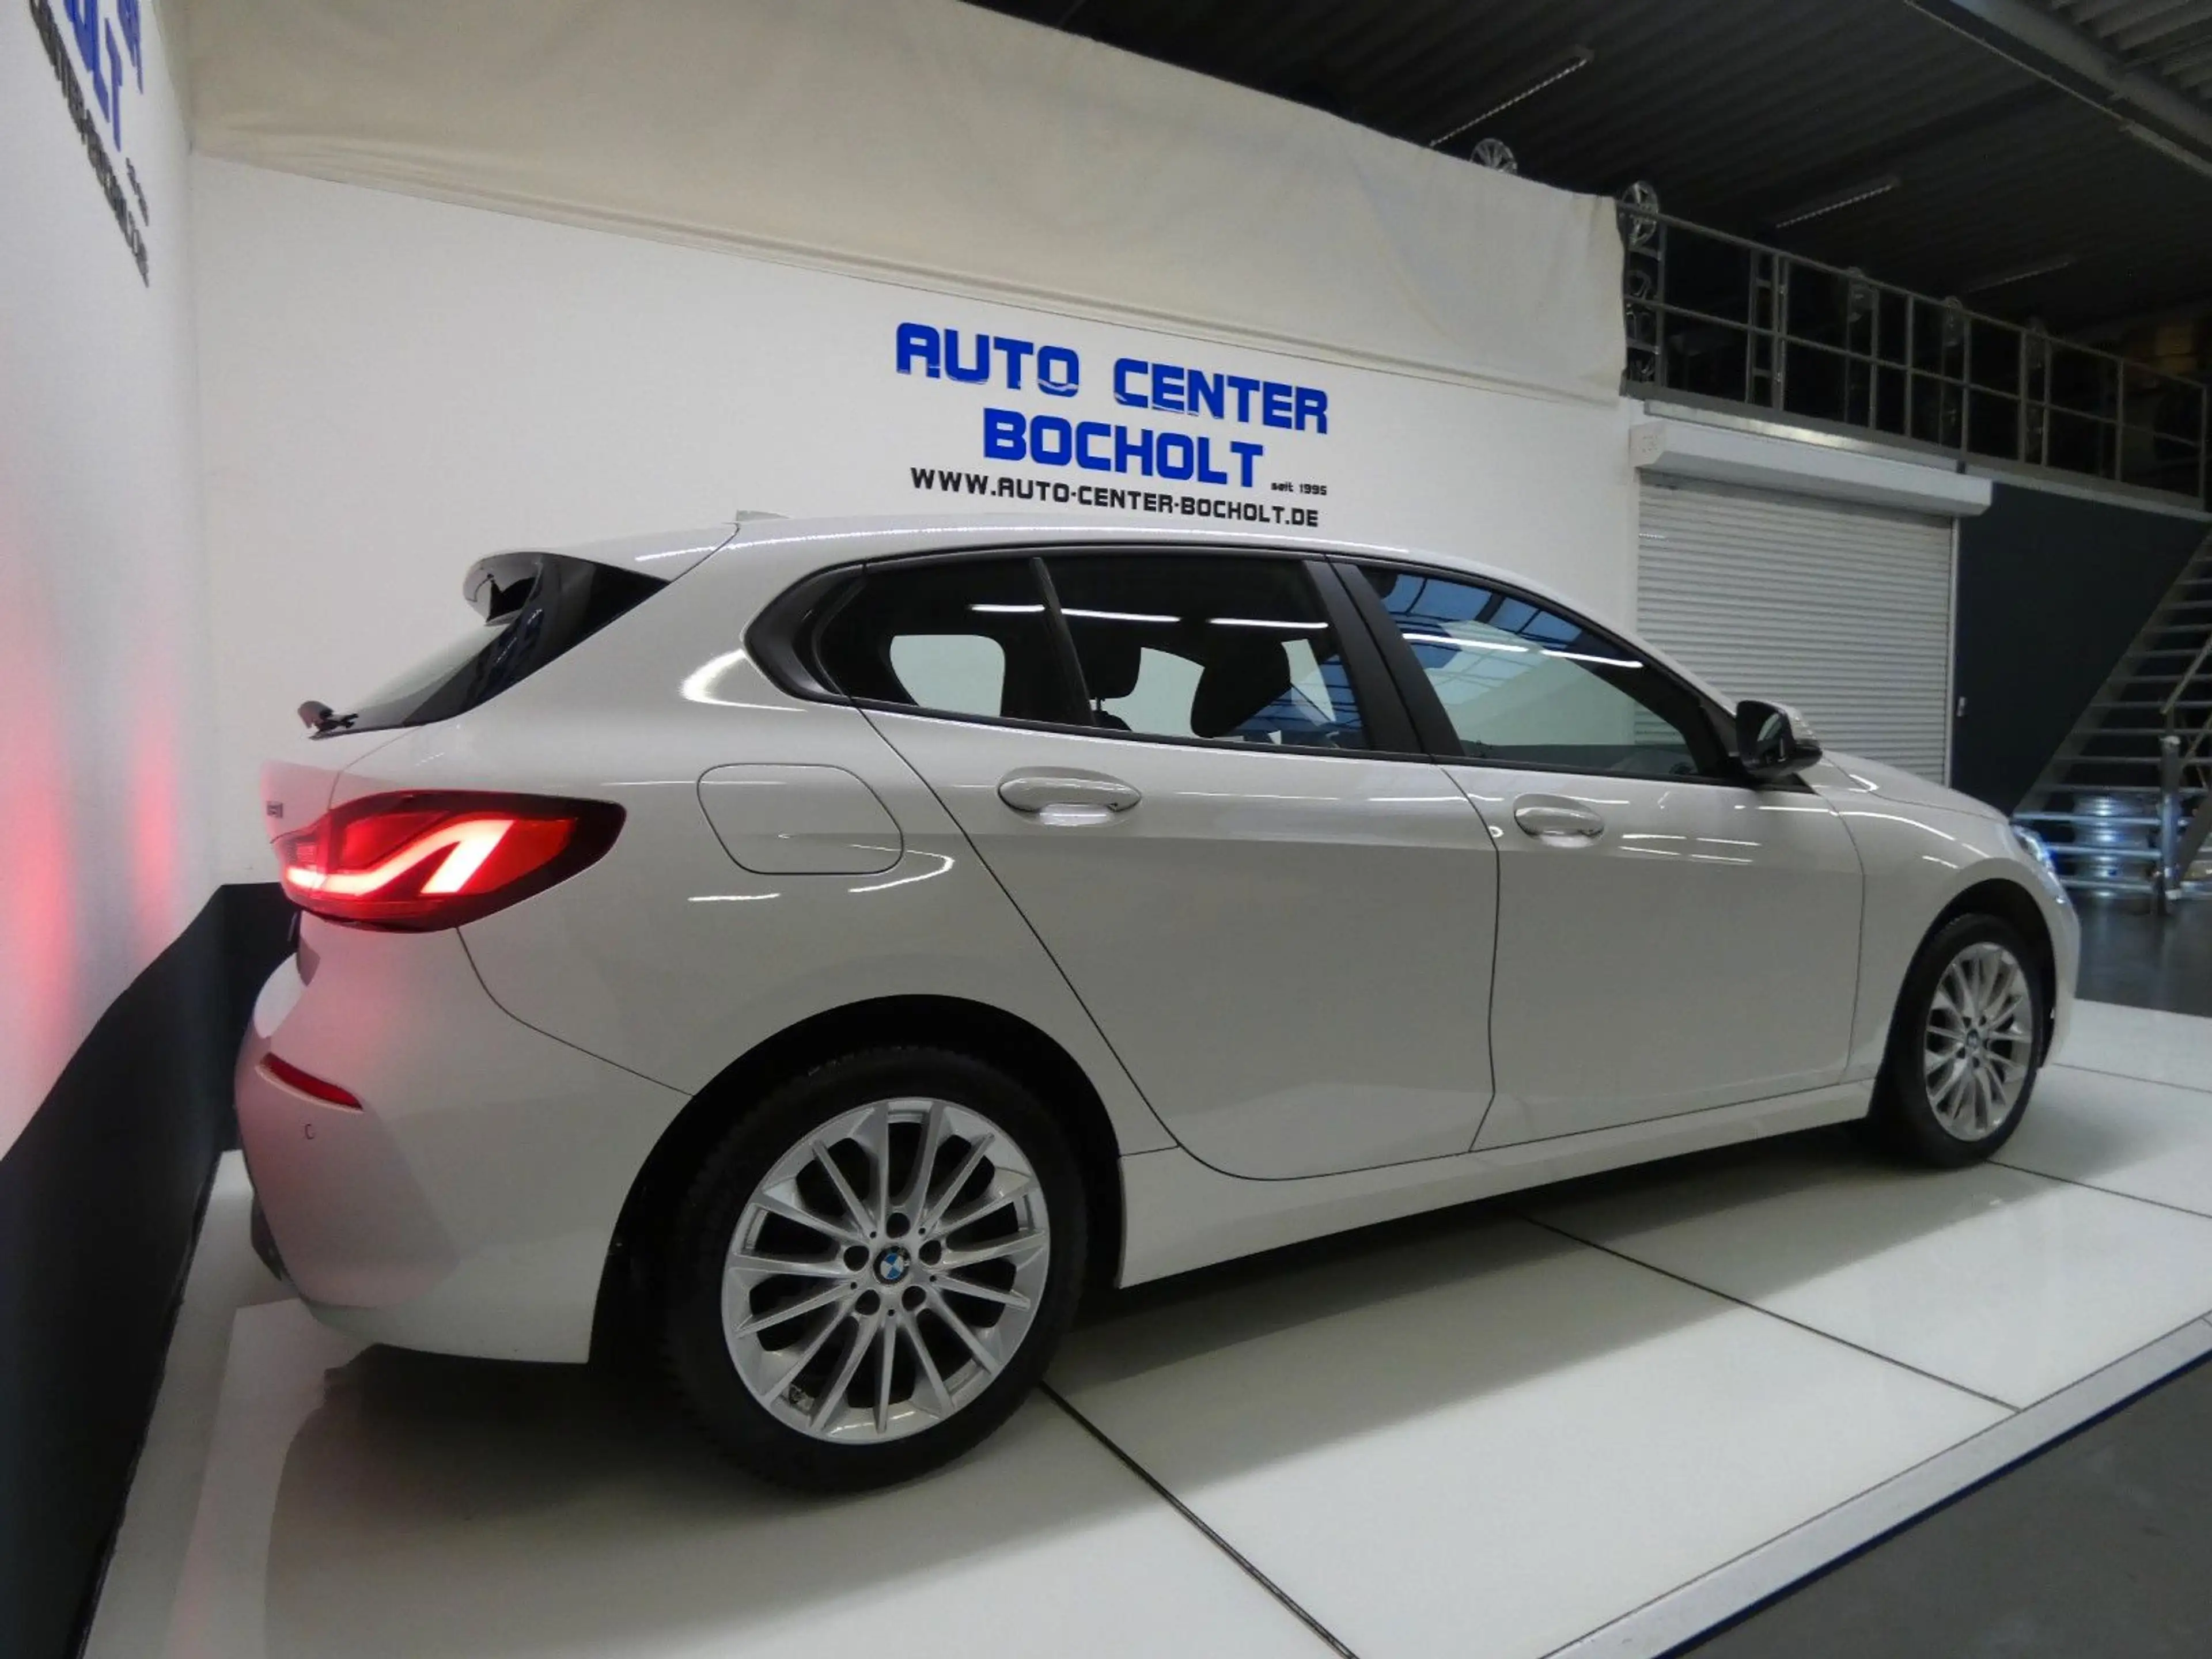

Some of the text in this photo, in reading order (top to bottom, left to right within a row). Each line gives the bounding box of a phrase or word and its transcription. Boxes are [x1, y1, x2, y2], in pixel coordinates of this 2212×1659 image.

[896, 323, 1327, 434] AUTO CENTER
[983, 407, 1263, 488] BOCHOLT
[1299, 483, 1327, 496] 1995
